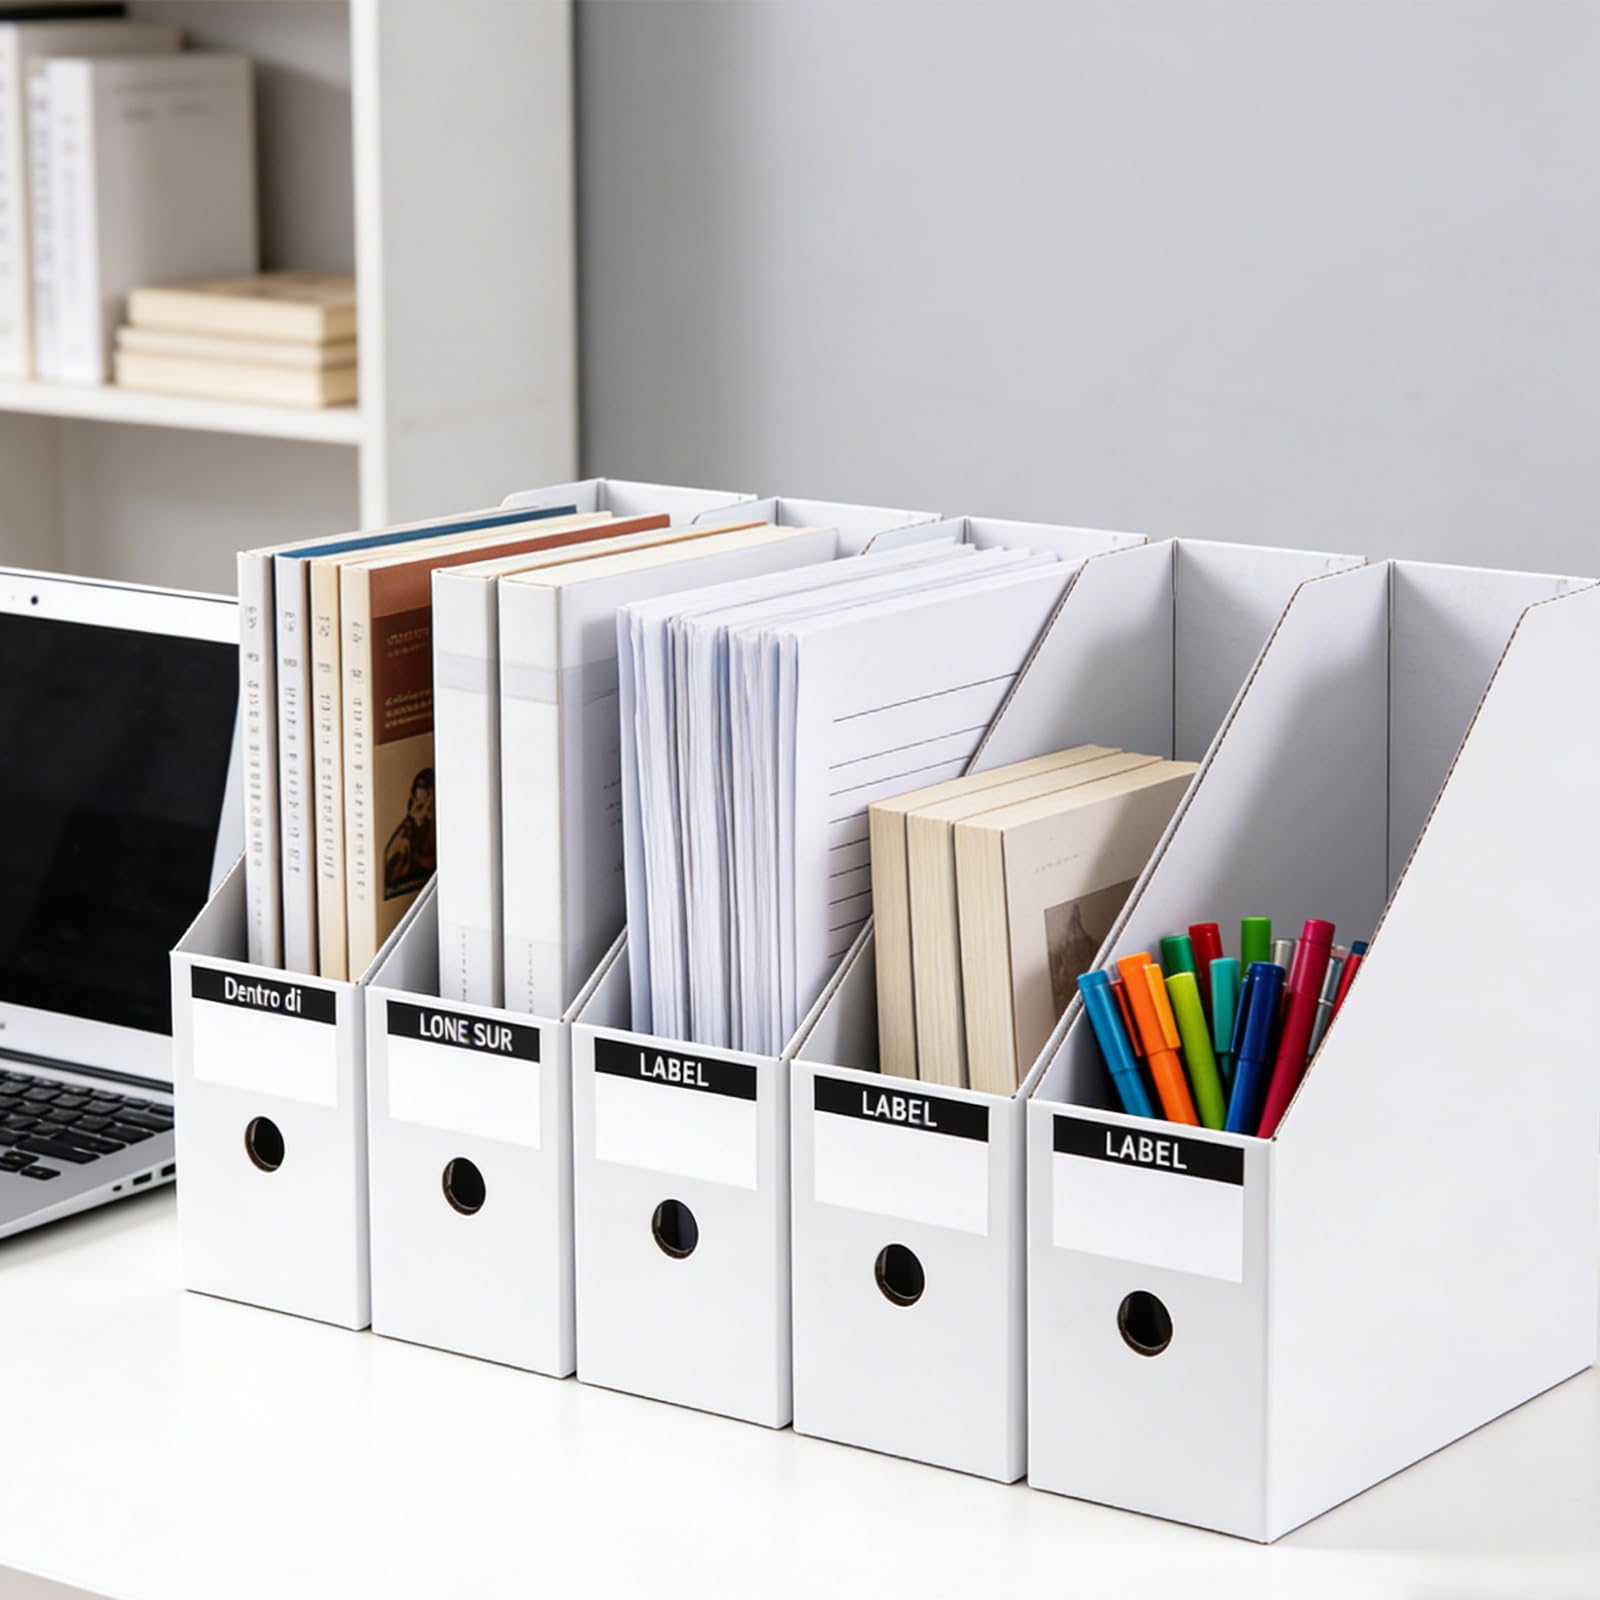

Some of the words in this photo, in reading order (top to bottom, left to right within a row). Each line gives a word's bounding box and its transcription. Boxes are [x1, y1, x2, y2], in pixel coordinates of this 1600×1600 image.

[224, 976, 281, 1008] Dentro
[285, 987, 302, 1013] di
[420, 1012, 470, 1045] LONE
[473, 1023, 513, 1052] SUR
[640, 1052, 710, 1087] LABEL
[862, 1090, 938, 1127] LABEL
[1106, 1131, 1188, 1169] LABEL
